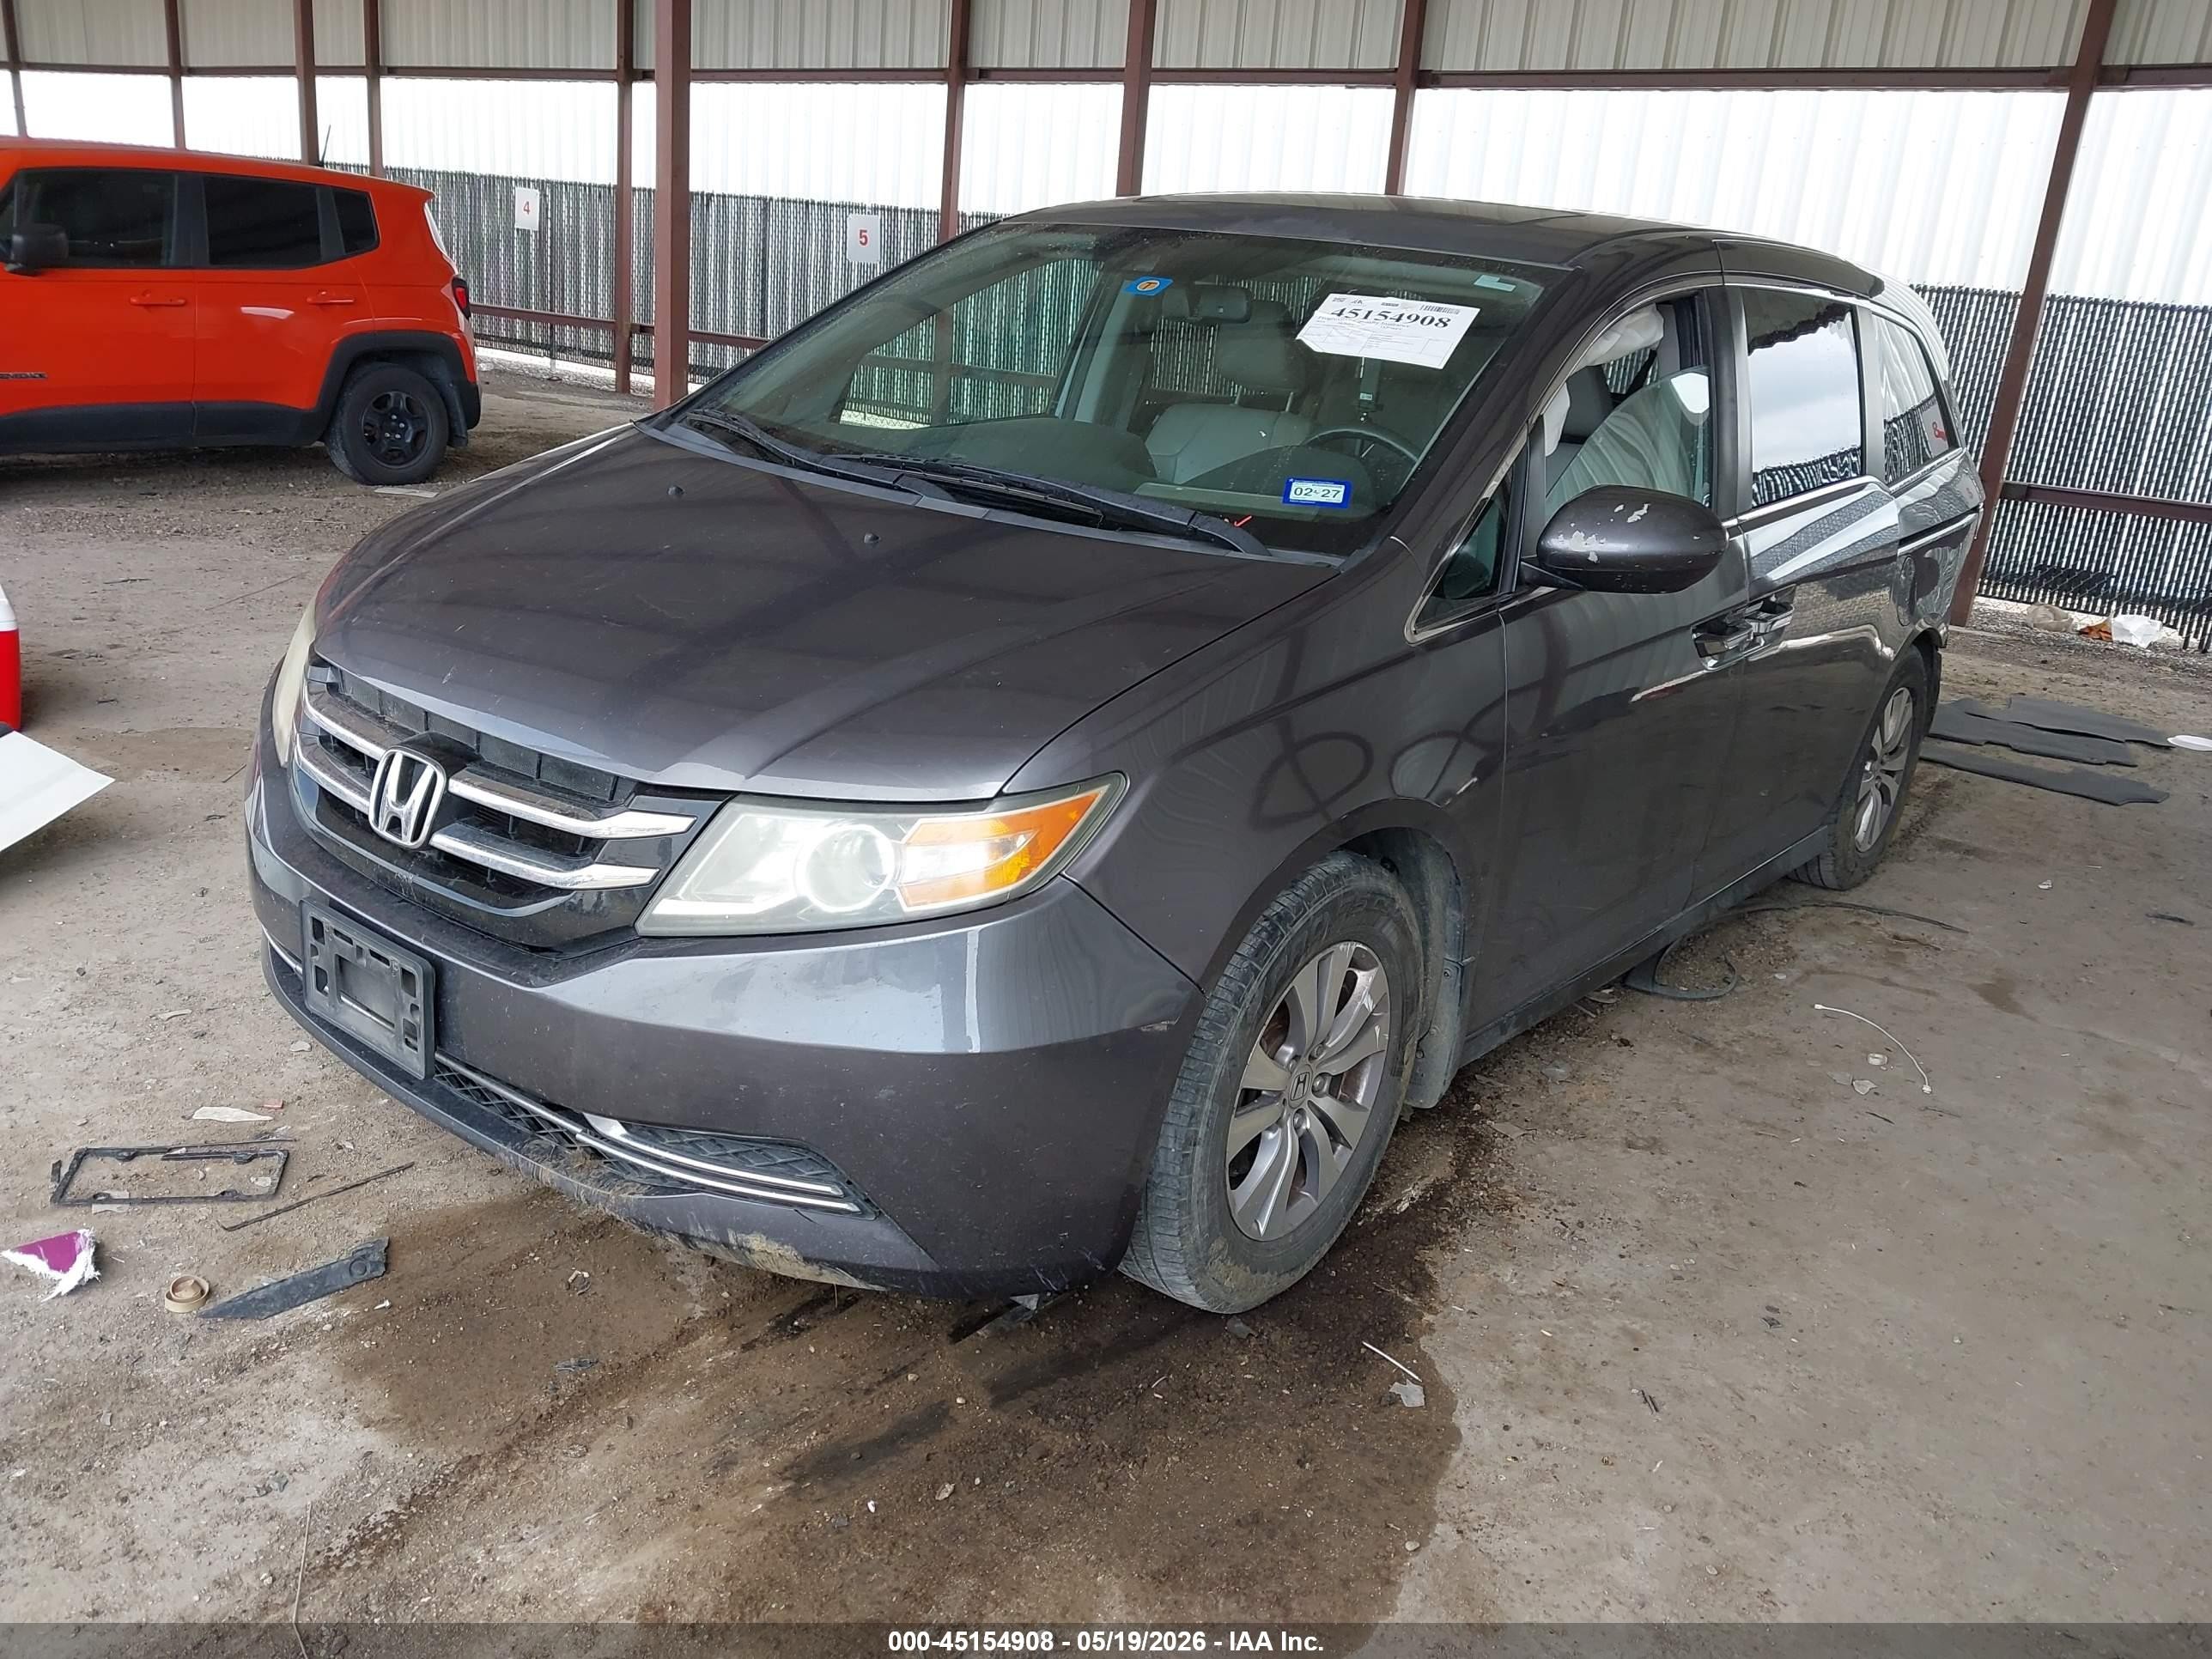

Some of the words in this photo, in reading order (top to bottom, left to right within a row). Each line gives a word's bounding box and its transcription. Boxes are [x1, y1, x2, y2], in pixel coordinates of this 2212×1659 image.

[522, 200, 531, 216] 4
[859, 228, 868, 246] 5
[1331, 307, 1452, 329] 45154908
